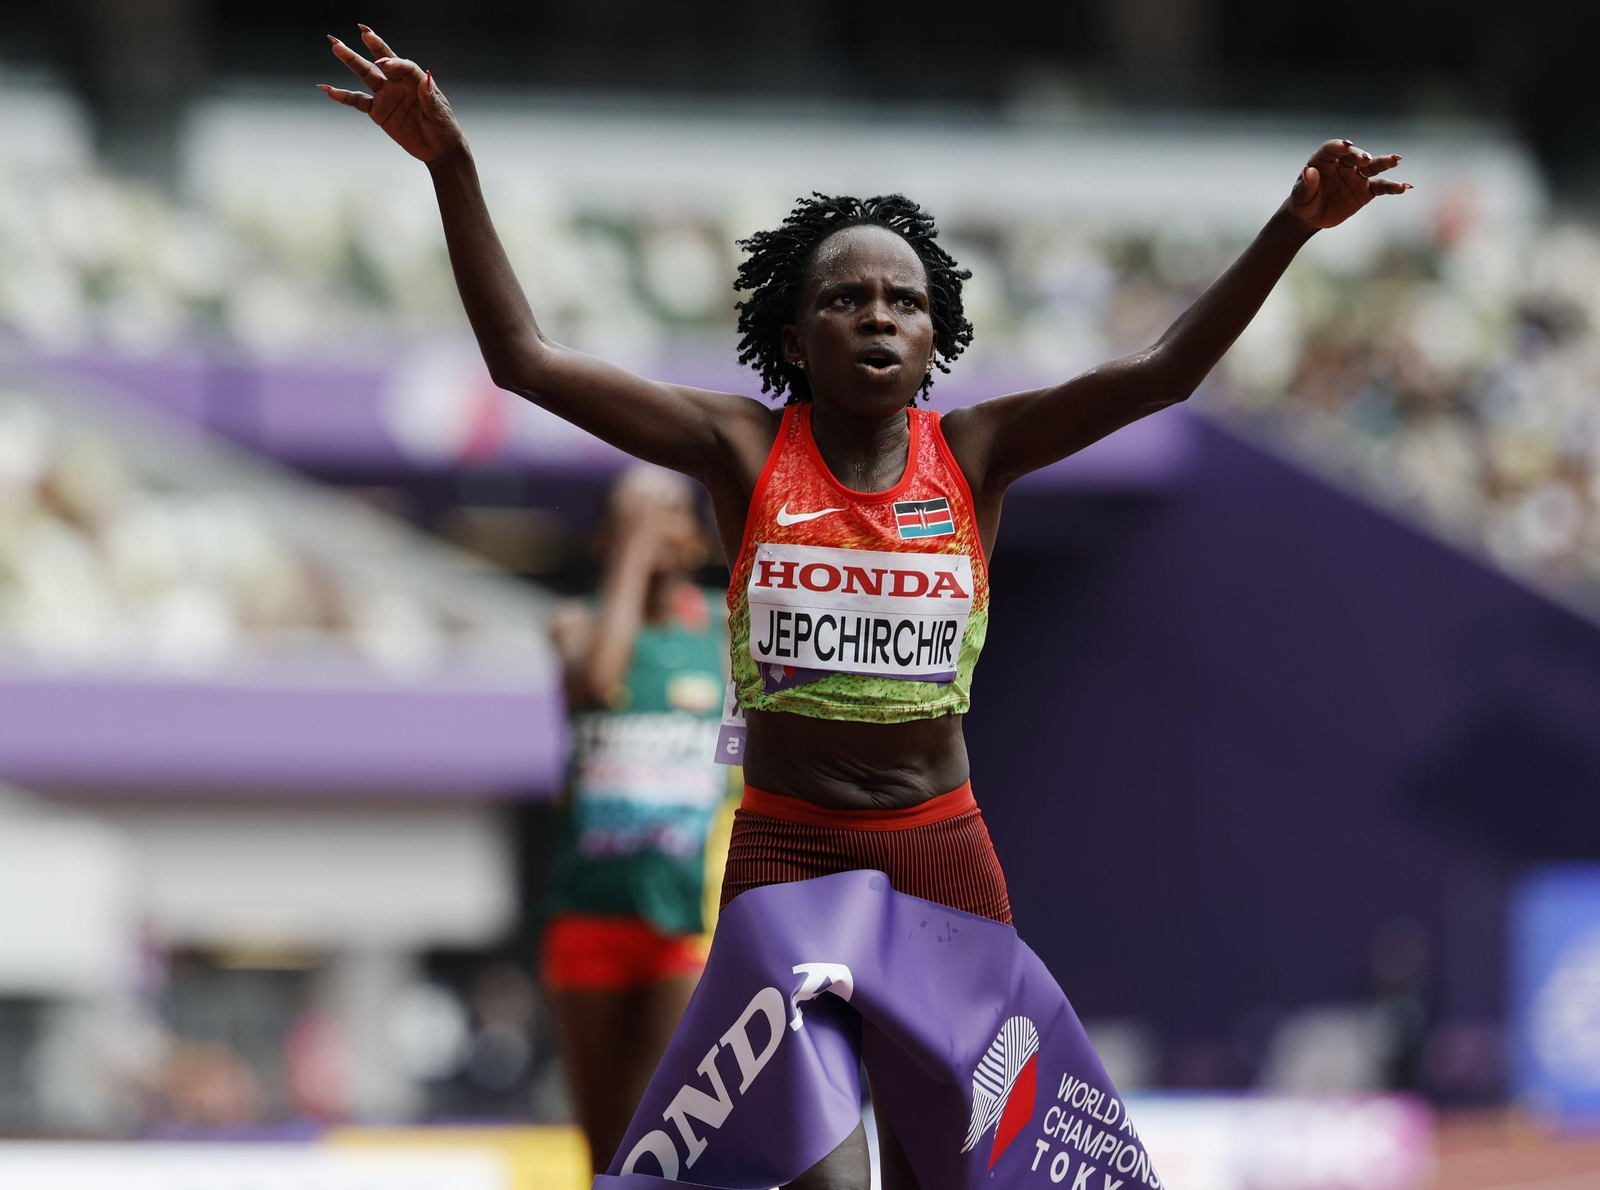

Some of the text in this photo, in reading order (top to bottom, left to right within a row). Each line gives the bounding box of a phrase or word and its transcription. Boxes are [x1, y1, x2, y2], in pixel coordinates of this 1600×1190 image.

[754, 560, 969, 599] HONDA
[757, 610, 958, 667] JEPCHIRCHIR
[1057, 1072, 1120, 1126] WORLD
[1043, 1105, 1165, 1190] CHAMPIONS
